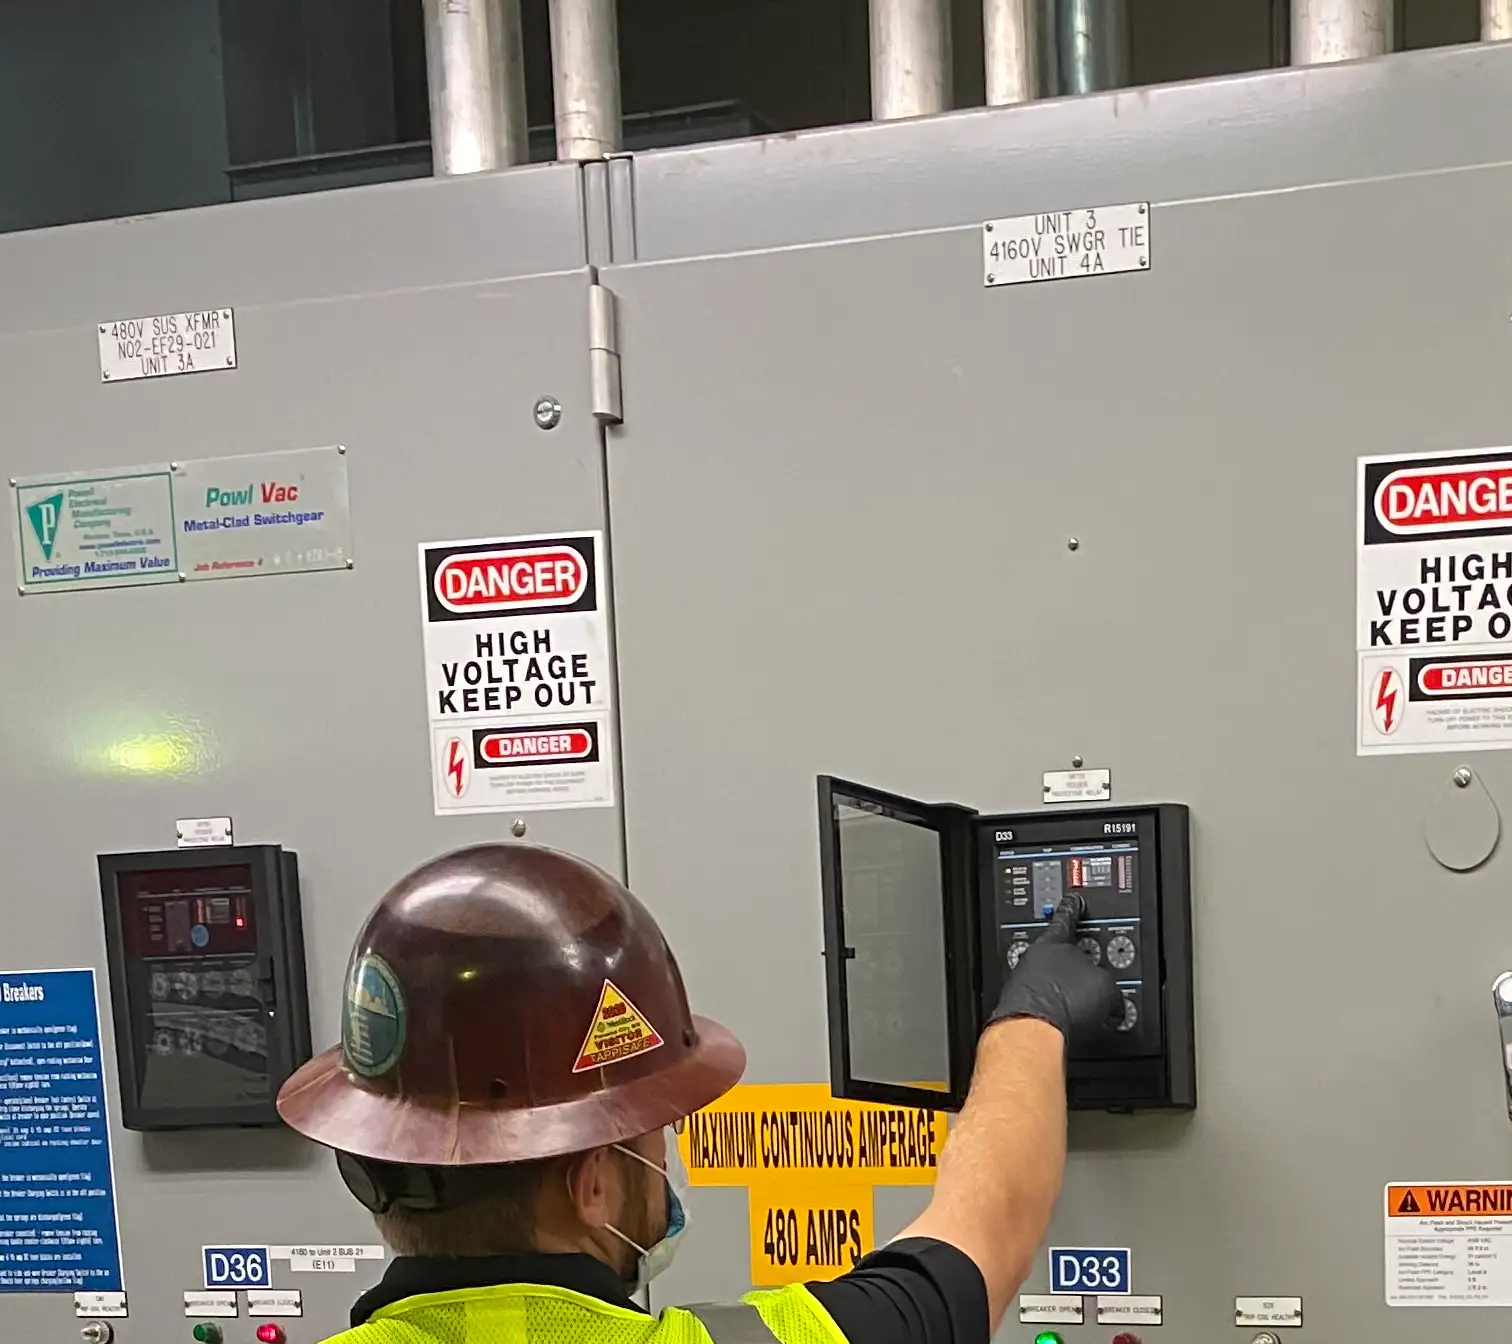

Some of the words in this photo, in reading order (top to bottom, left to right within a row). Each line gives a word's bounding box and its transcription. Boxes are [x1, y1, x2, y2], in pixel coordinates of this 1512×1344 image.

[1034, 212, 1072, 235] UNIT
[1085, 209, 1097, 231] 3
[990, 237, 1042, 261] 4160V
[1054, 230, 1106, 255] SWGR
[1118, 226, 1145, 248] TIE
[1029, 256, 1067, 279] UNIT
[1080, 252, 1105, 273] 4A
[111, 321, 144, 340] 480V
[152, 316, 177, 336] SUS
[185, 311, 221, 333] XFMR
[141, 356, 167, 376] UNIT
[177, 352, 194, 371] 3A
[205, 484, 254, 508] Powl
[260, 481, 298, 504] Vac
[253, 510, 325, 526] Switchgear
[32, 564, 81, 577] Providing
[84, 559, 136, 574] Maximum
[140, 556, 170, 569] Value
[445, 559, 576, 600] DANGER
[1420, 552, 1512, 584] HIGH
[475, 628, 551, 658] HIGH
[1370, 615, 1473, 647] KEEP
[441, 654, 589, 687] VOLTAGE
[438, 685, 522, 715] KEEP
[534, 680, 596, 708] OUT
[498, 735, 572, 756] DANGER
[995, 830, 1014, 842] D33
[3, 982, 45, 1002] Breakers
[689, 1111, 757, 1169] MAXIMUM
[759, 1110, 854, 1169] CONTINUOUS
[858, 1108, 937, 1169] AMPERAGE
[764, 1208, 799, 1266] 480
[805, 1209, 863, 1266] AMPS
[209, 1252, 263, 1282] D36
[1059, 1255, 1121, 1288] D33
